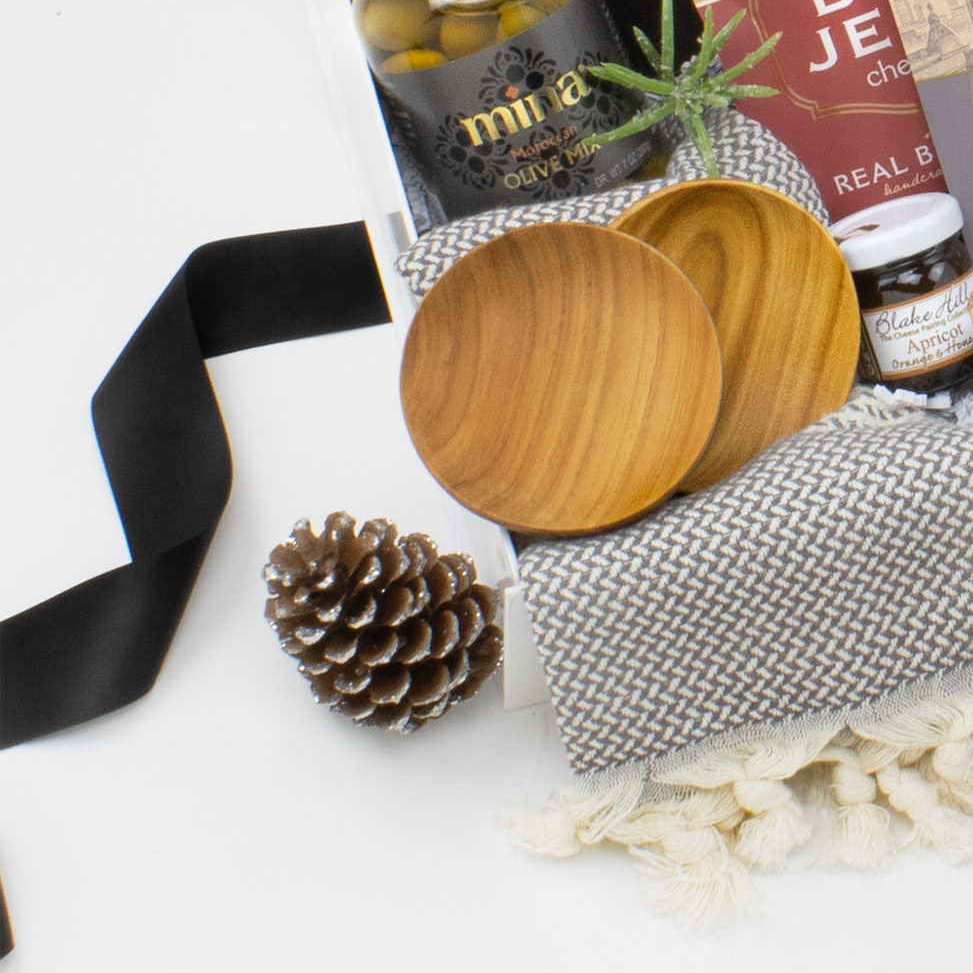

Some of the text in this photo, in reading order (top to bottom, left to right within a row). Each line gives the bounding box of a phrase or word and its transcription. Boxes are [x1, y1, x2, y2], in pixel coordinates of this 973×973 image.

[460, 70, 593, 147] mina
[509, 125, 577, 159] Moroccan
[504, 155, 564, 189] OLIVE
[833, 156, 909, 196] REAL
[875, 283, 970, 335] Blake Hill
[879, 334, 893, 342] The
[894, 328, 920, 340] Cheese
[921, 318, 946, 334] Pairing
[907, 324, 964, 354] Apricot
[892, 354, 934, 370] Orange
[936, 349, 944, 358] &
